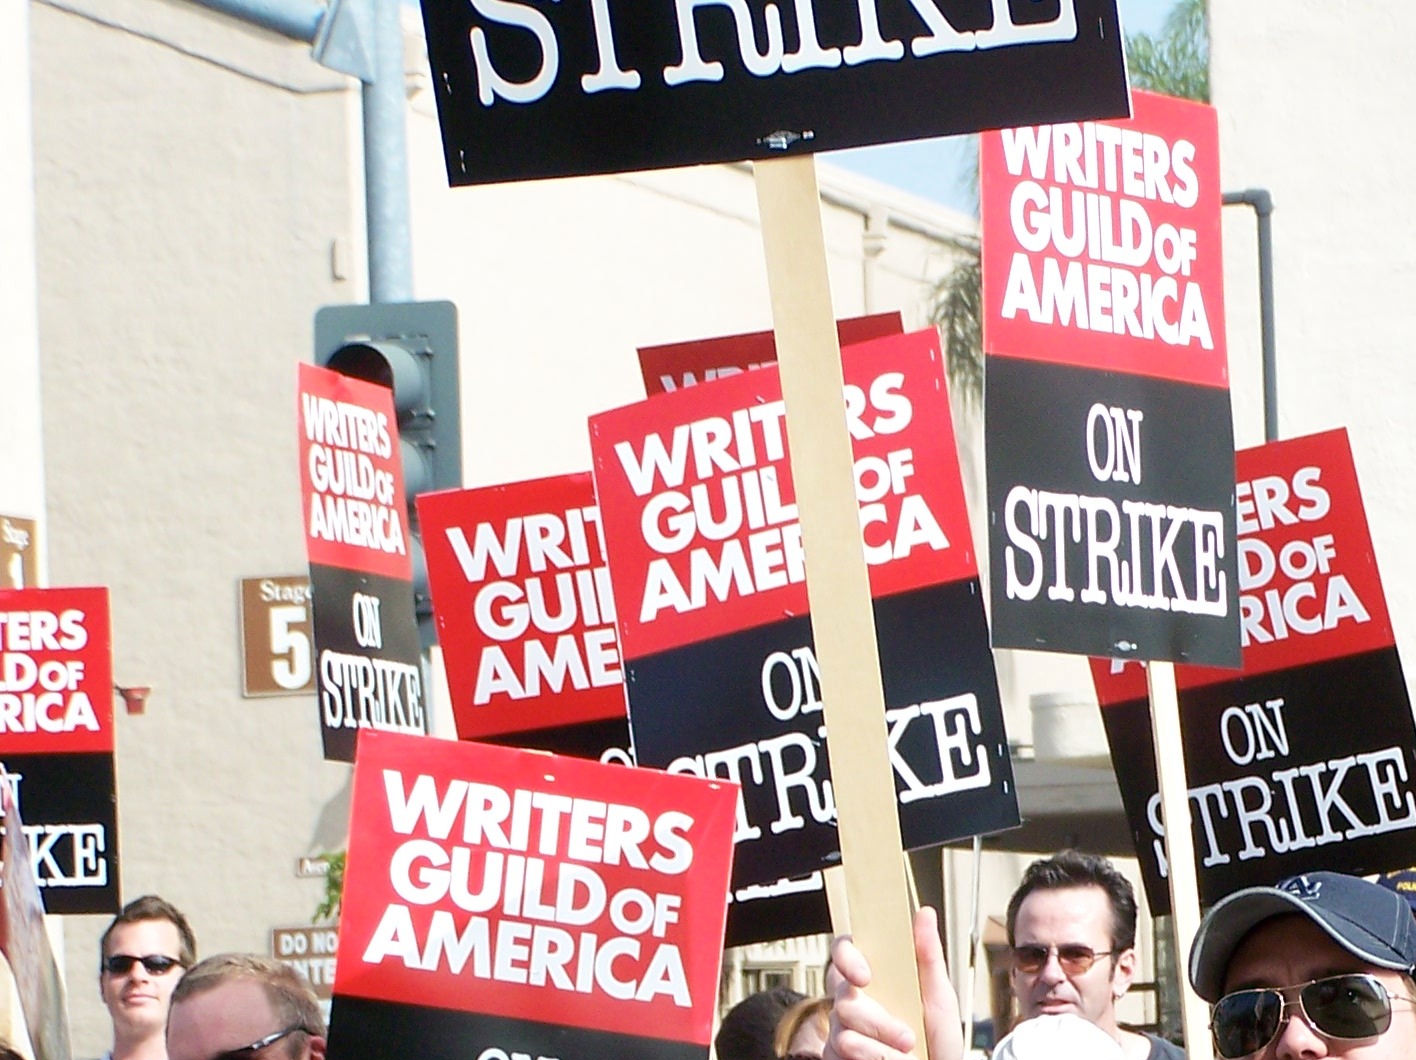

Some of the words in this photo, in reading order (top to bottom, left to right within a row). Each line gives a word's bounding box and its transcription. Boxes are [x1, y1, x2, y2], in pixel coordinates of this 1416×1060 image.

[1002, 124, 1199, 209] WRITERS
[1009, 183, 1151, 265] GUILD
[1153, 229, 1197, 278] OF
[1001, 252, 1215, 350] AMERICA
[302, 392, 393, 460] WRITERS
[613, 372, 913, 496] WRITRS
[1086, 403, 1144, 485] ON
[308, 442, 376, 501] GUILD
[374, 468, 395, 506] OF
[640, 465, 799, 555] GUIL
[852, 447, 915, 503] OF
[310, 491, 407, 556] AMERICA
[638, 490, 950, 624] AMECA
[1004, 487, 1228, 618] STRIKE
[1279, 534, 1336, 580] OF
[269, 606, 312, 690] 5
[353, 592, 381, 650] ON
[38, 661, 85, 692] OF
[320, 649, 426, 736] STRIKE
[1220, 699, 1290, 766] ON
[381, 769, 694, 875] WRITERS
[389, 839, 609, 926] GUILD
[609, 887, 682, 939] OF
[279, 933, 307, 955] DO
[362, 915, 693, 1008] AMERICA
